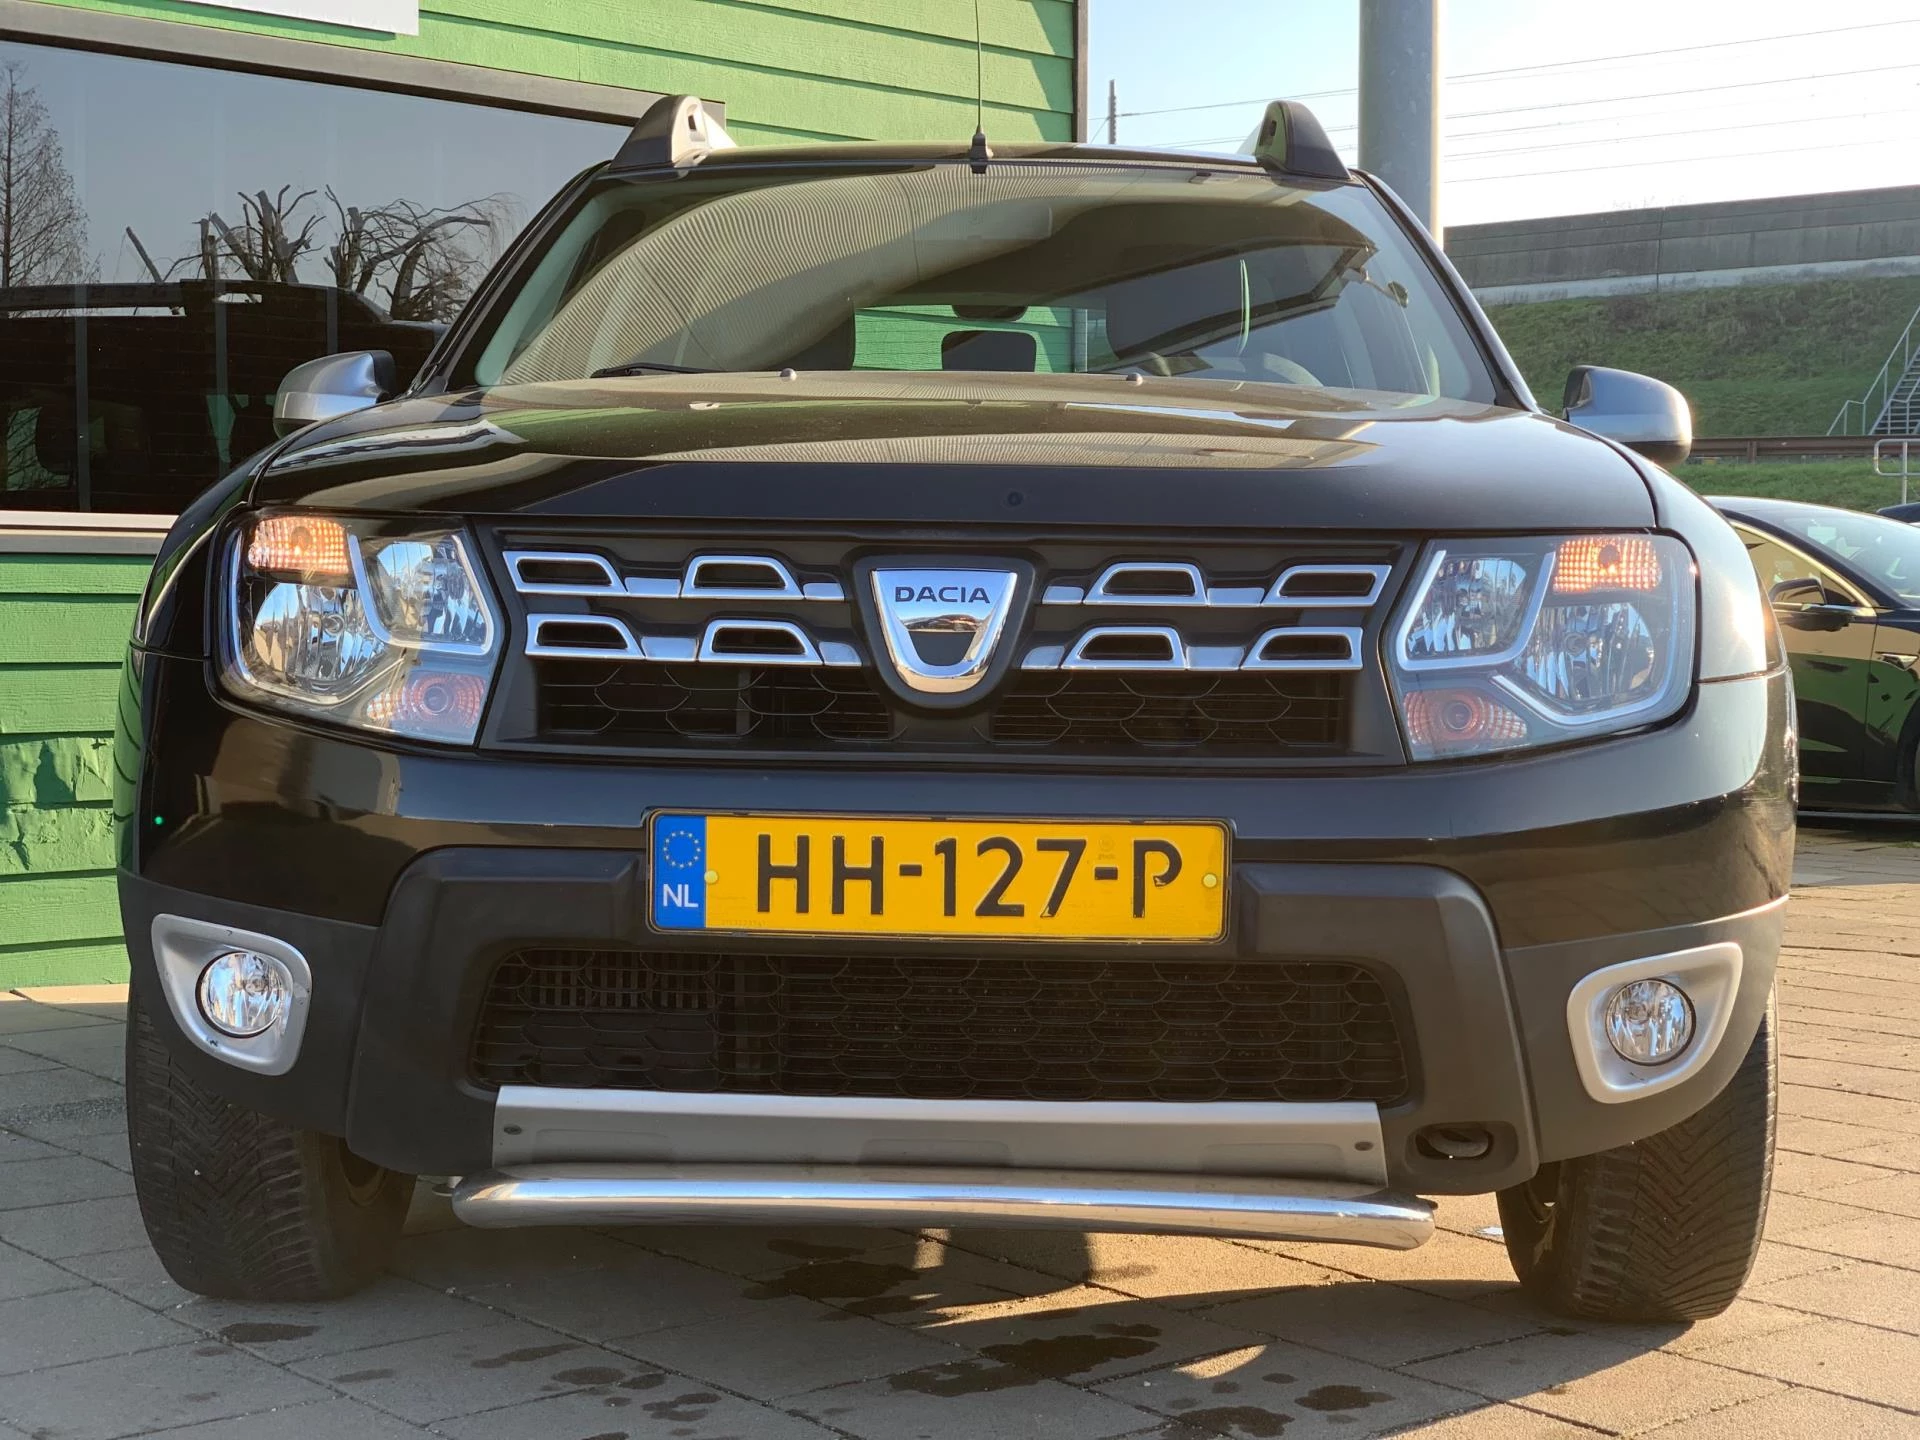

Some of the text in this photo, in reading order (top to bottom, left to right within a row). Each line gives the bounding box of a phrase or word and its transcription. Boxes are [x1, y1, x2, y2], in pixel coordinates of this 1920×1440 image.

[895, 586, 990, 604] DACIA
[757, 833, 1183, 919] HH-127-P
[663, 883, 699, 908] NL
